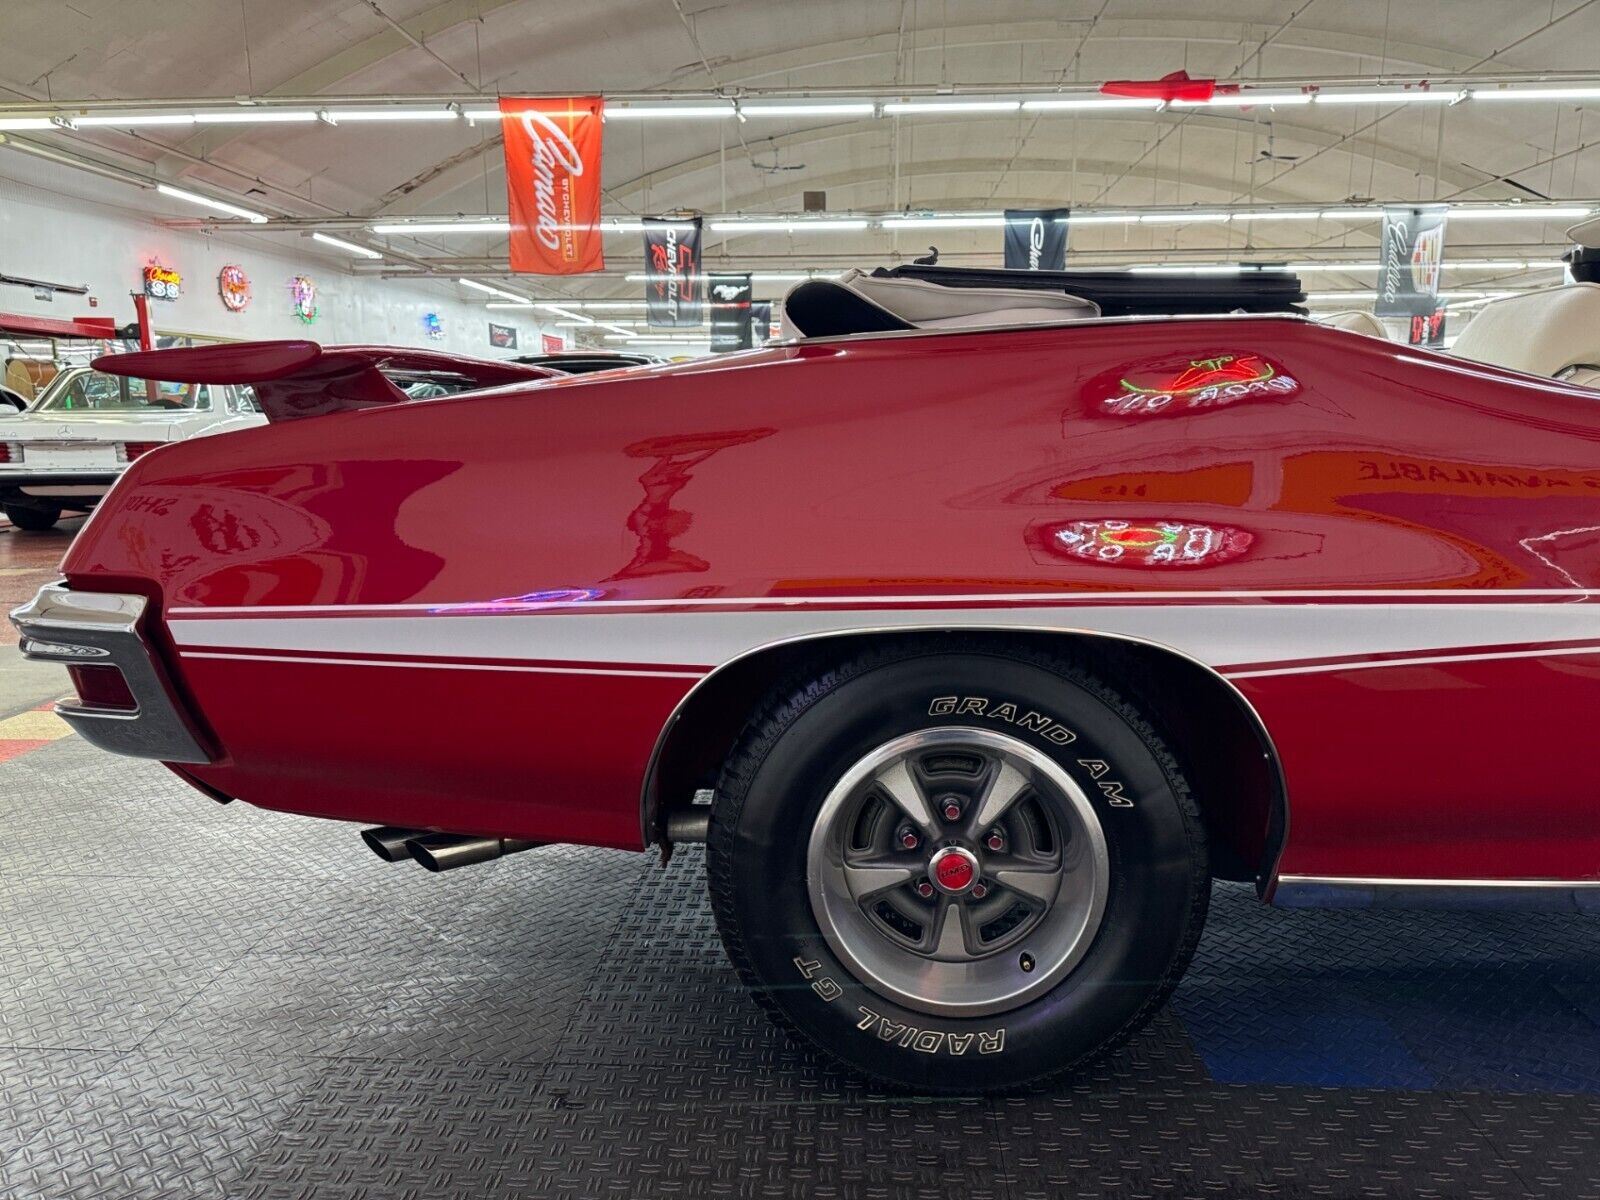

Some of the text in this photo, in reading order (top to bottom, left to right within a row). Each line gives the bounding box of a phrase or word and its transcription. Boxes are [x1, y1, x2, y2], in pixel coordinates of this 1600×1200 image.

[521, 110, 584, 250] Camaro
[666, 228, 678, 320] CHEVROLET
[1384, 221, 1408, 304] Cadillac
[928, 696, 1135, 808] GRAND AM
[793, 956, 1006, 1056] RADIAL GT
